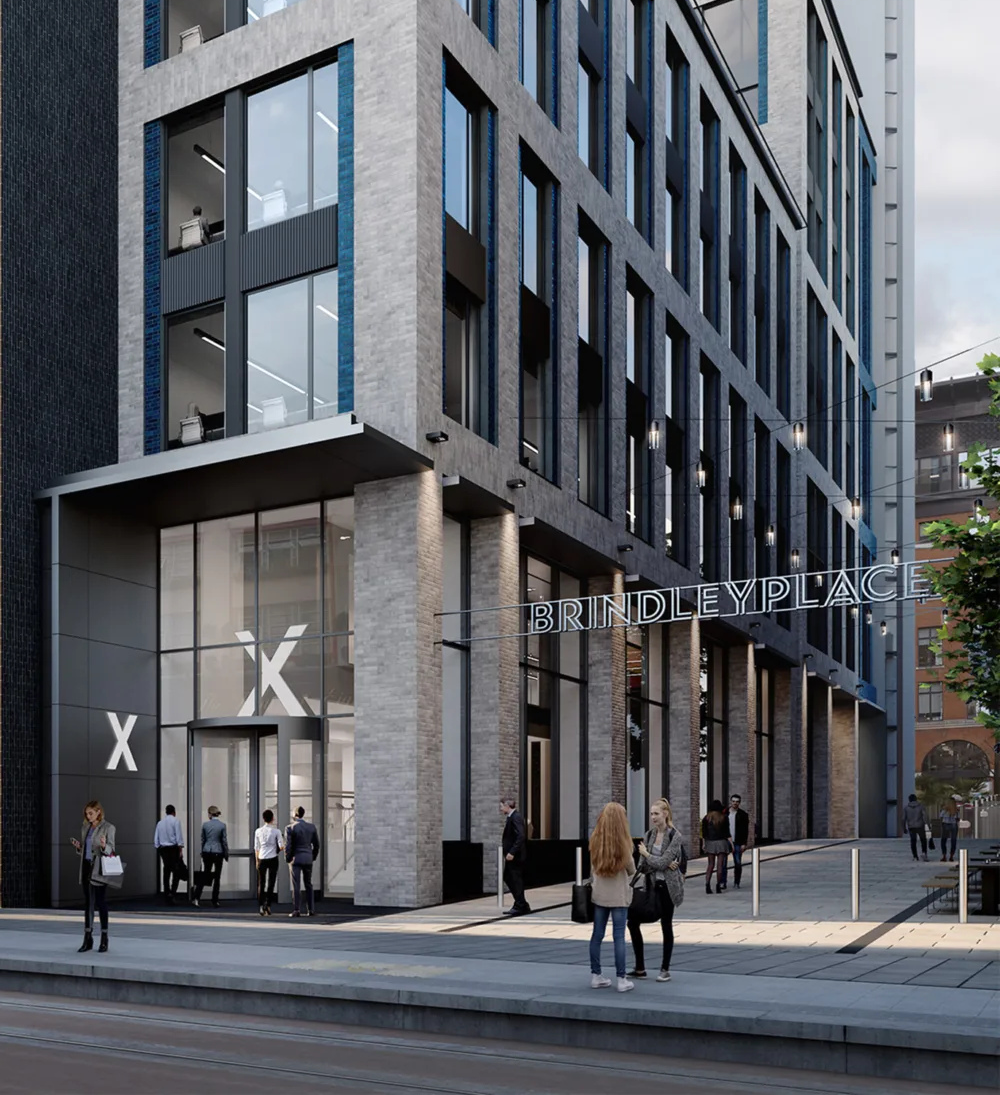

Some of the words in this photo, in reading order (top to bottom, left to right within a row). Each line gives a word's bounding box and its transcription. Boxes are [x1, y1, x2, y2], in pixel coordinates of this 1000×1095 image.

[529, 561, 932, 635] BRINDLEYPLACE
[235, 624, 308, 717] X
[106, 711, 138, 771] X
